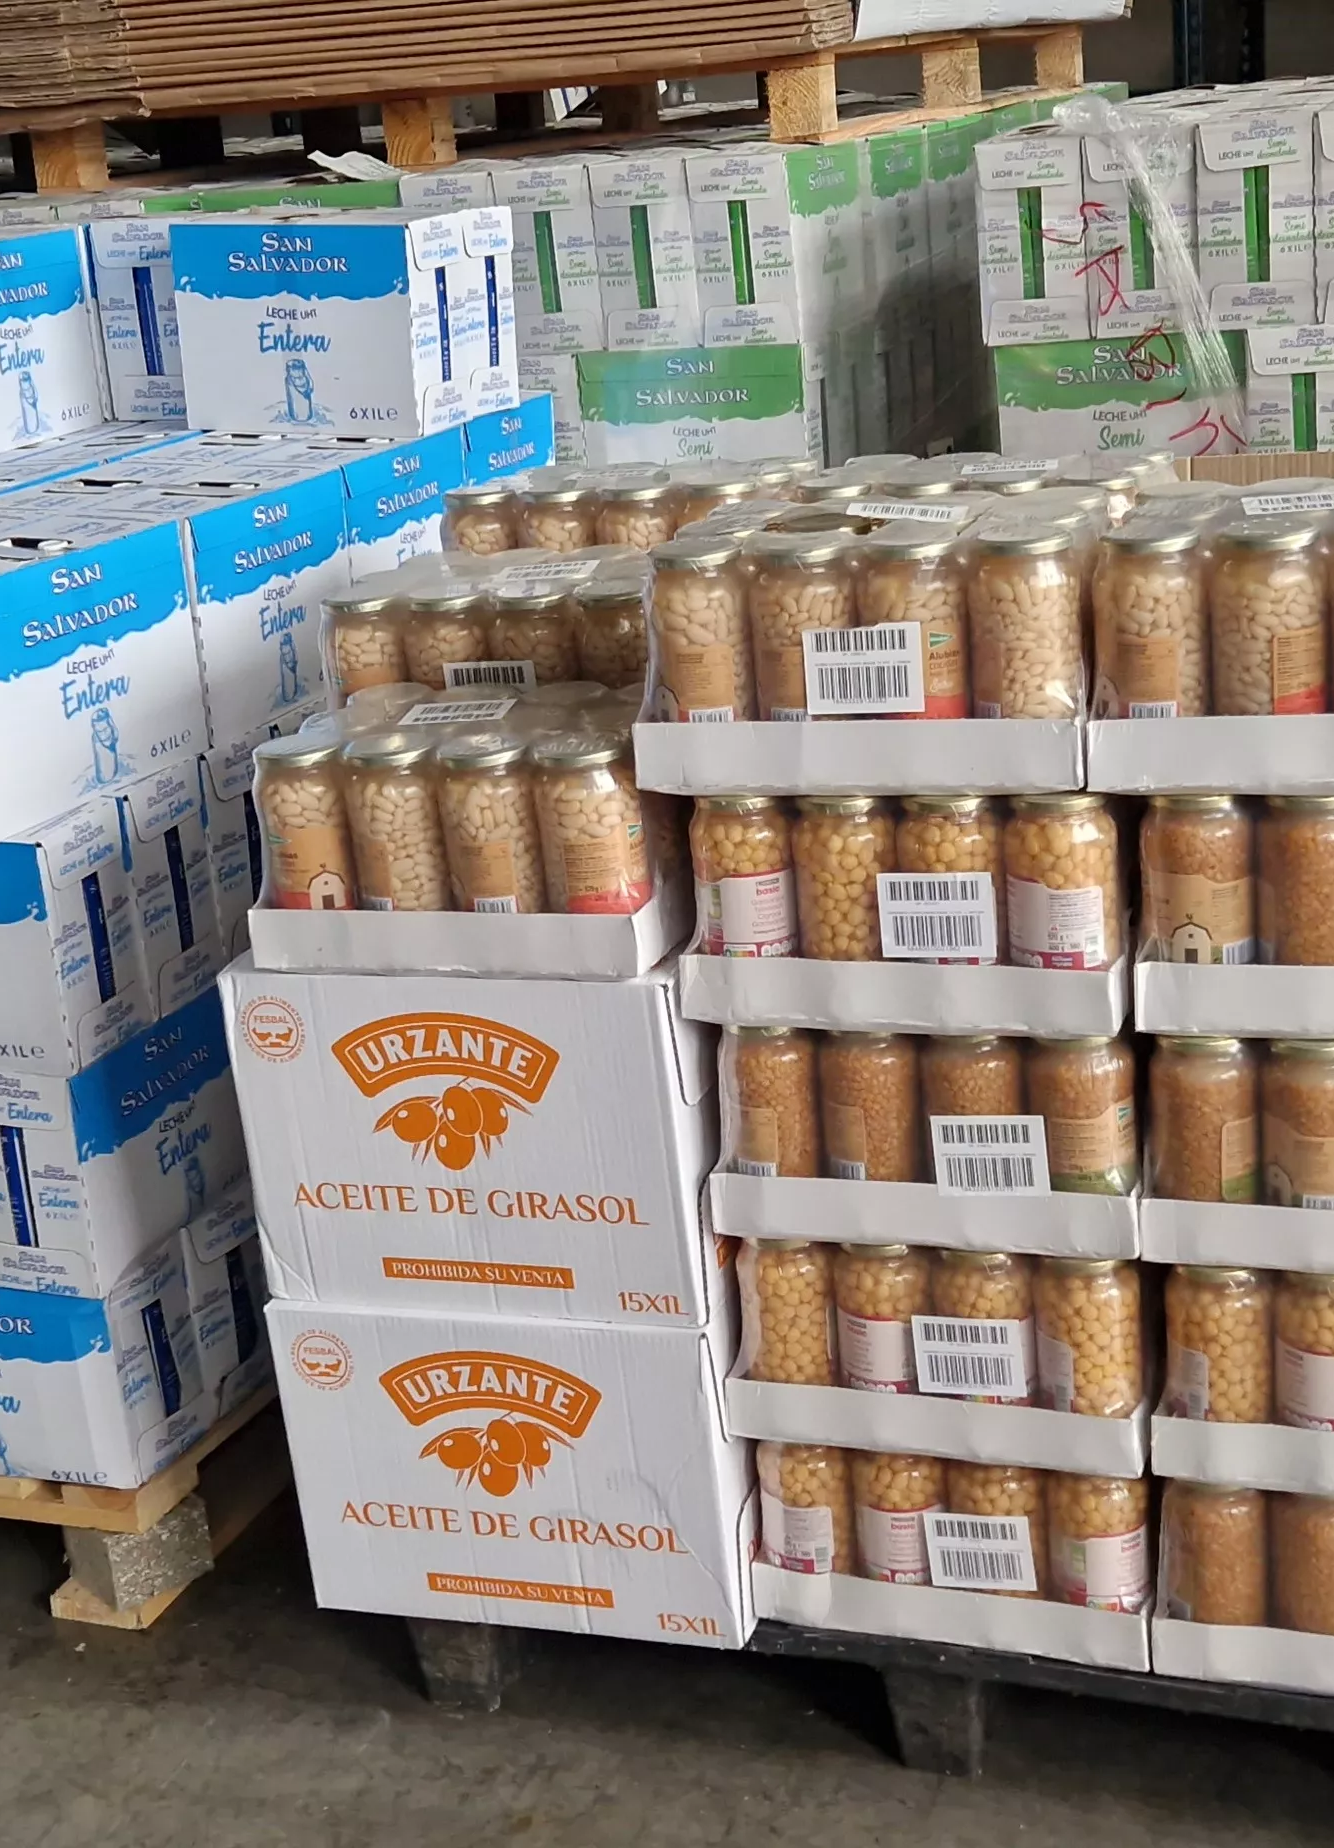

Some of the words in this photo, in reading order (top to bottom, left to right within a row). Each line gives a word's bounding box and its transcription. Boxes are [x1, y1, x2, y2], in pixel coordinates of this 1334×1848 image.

[261, 231, 313, 253] SAN
[227, 251, 349, 274] SALVADOR
[266, 305, 299, 321] LECHE
[0, 327, 22, 341] LECHE
[257, 321, 332, 354] Entera
[666, 357, 715, 376] SAN
[1092, 344, 1148, 366] SAN
[1056, 363, 1184, 388] SALVADOR
[634, 386, 750, 407] SALVADOR
[499, 416, 523, 436] SAN
[1092, 408, 1125, 424] LECHE
[672, 425, 700, 439] LECHE
[1096, 426, 1146, 451] Semi
[487, 439, 536, 471] SALVADOR
[675, 438, 714, 459] Semi
[392, 453, 422, 478] SAN
[375, 481, 441, 517] SALVADOR
[253, 504, 289, 528] SAN
[233, 530, 313, 573] SALVADOR
[50, 563, 103, 594] SAN
[263, 584, 285, 601] LECHE
[22, 593, 138, 648] SALVADOR
[259, 603, 307, 640] Entera
[66, 655, 97, 674] LECHE
[59, 673, 131, 720] Entera
[143, 1027, 183, 1062] SAN
[356, 1026, 534, 1079] URZANTE
[120, 1045, 210, 1117] SALVADOR
[159, 1112, 185, 1134] LECHE
[154, 1123, 212, 1175] Entera
[294, 1182, 419, 1213] ACEITE
[426, 1186, 477, 1216] DE
[487, 1188, 651, 1227] GIRASOL
[392, 1262, 480, 1279] PROHIBIDA
[485, 1267, 507, 1281] SU
[509, 1269, 565, 1286] VENTA
[401, 1364, 576, 1416] URZANTE
[341, 1501, 462, 1534] ACEITE
[469, 1510, 520, 1539] DE
[530, 1516, 689, 1555] GIRASOL
[436, 1577, 523, 1598] PROHIBIDA
[527, 1585, 548, 1599] SU
[551, 1588, 606, 1605] VENTA
